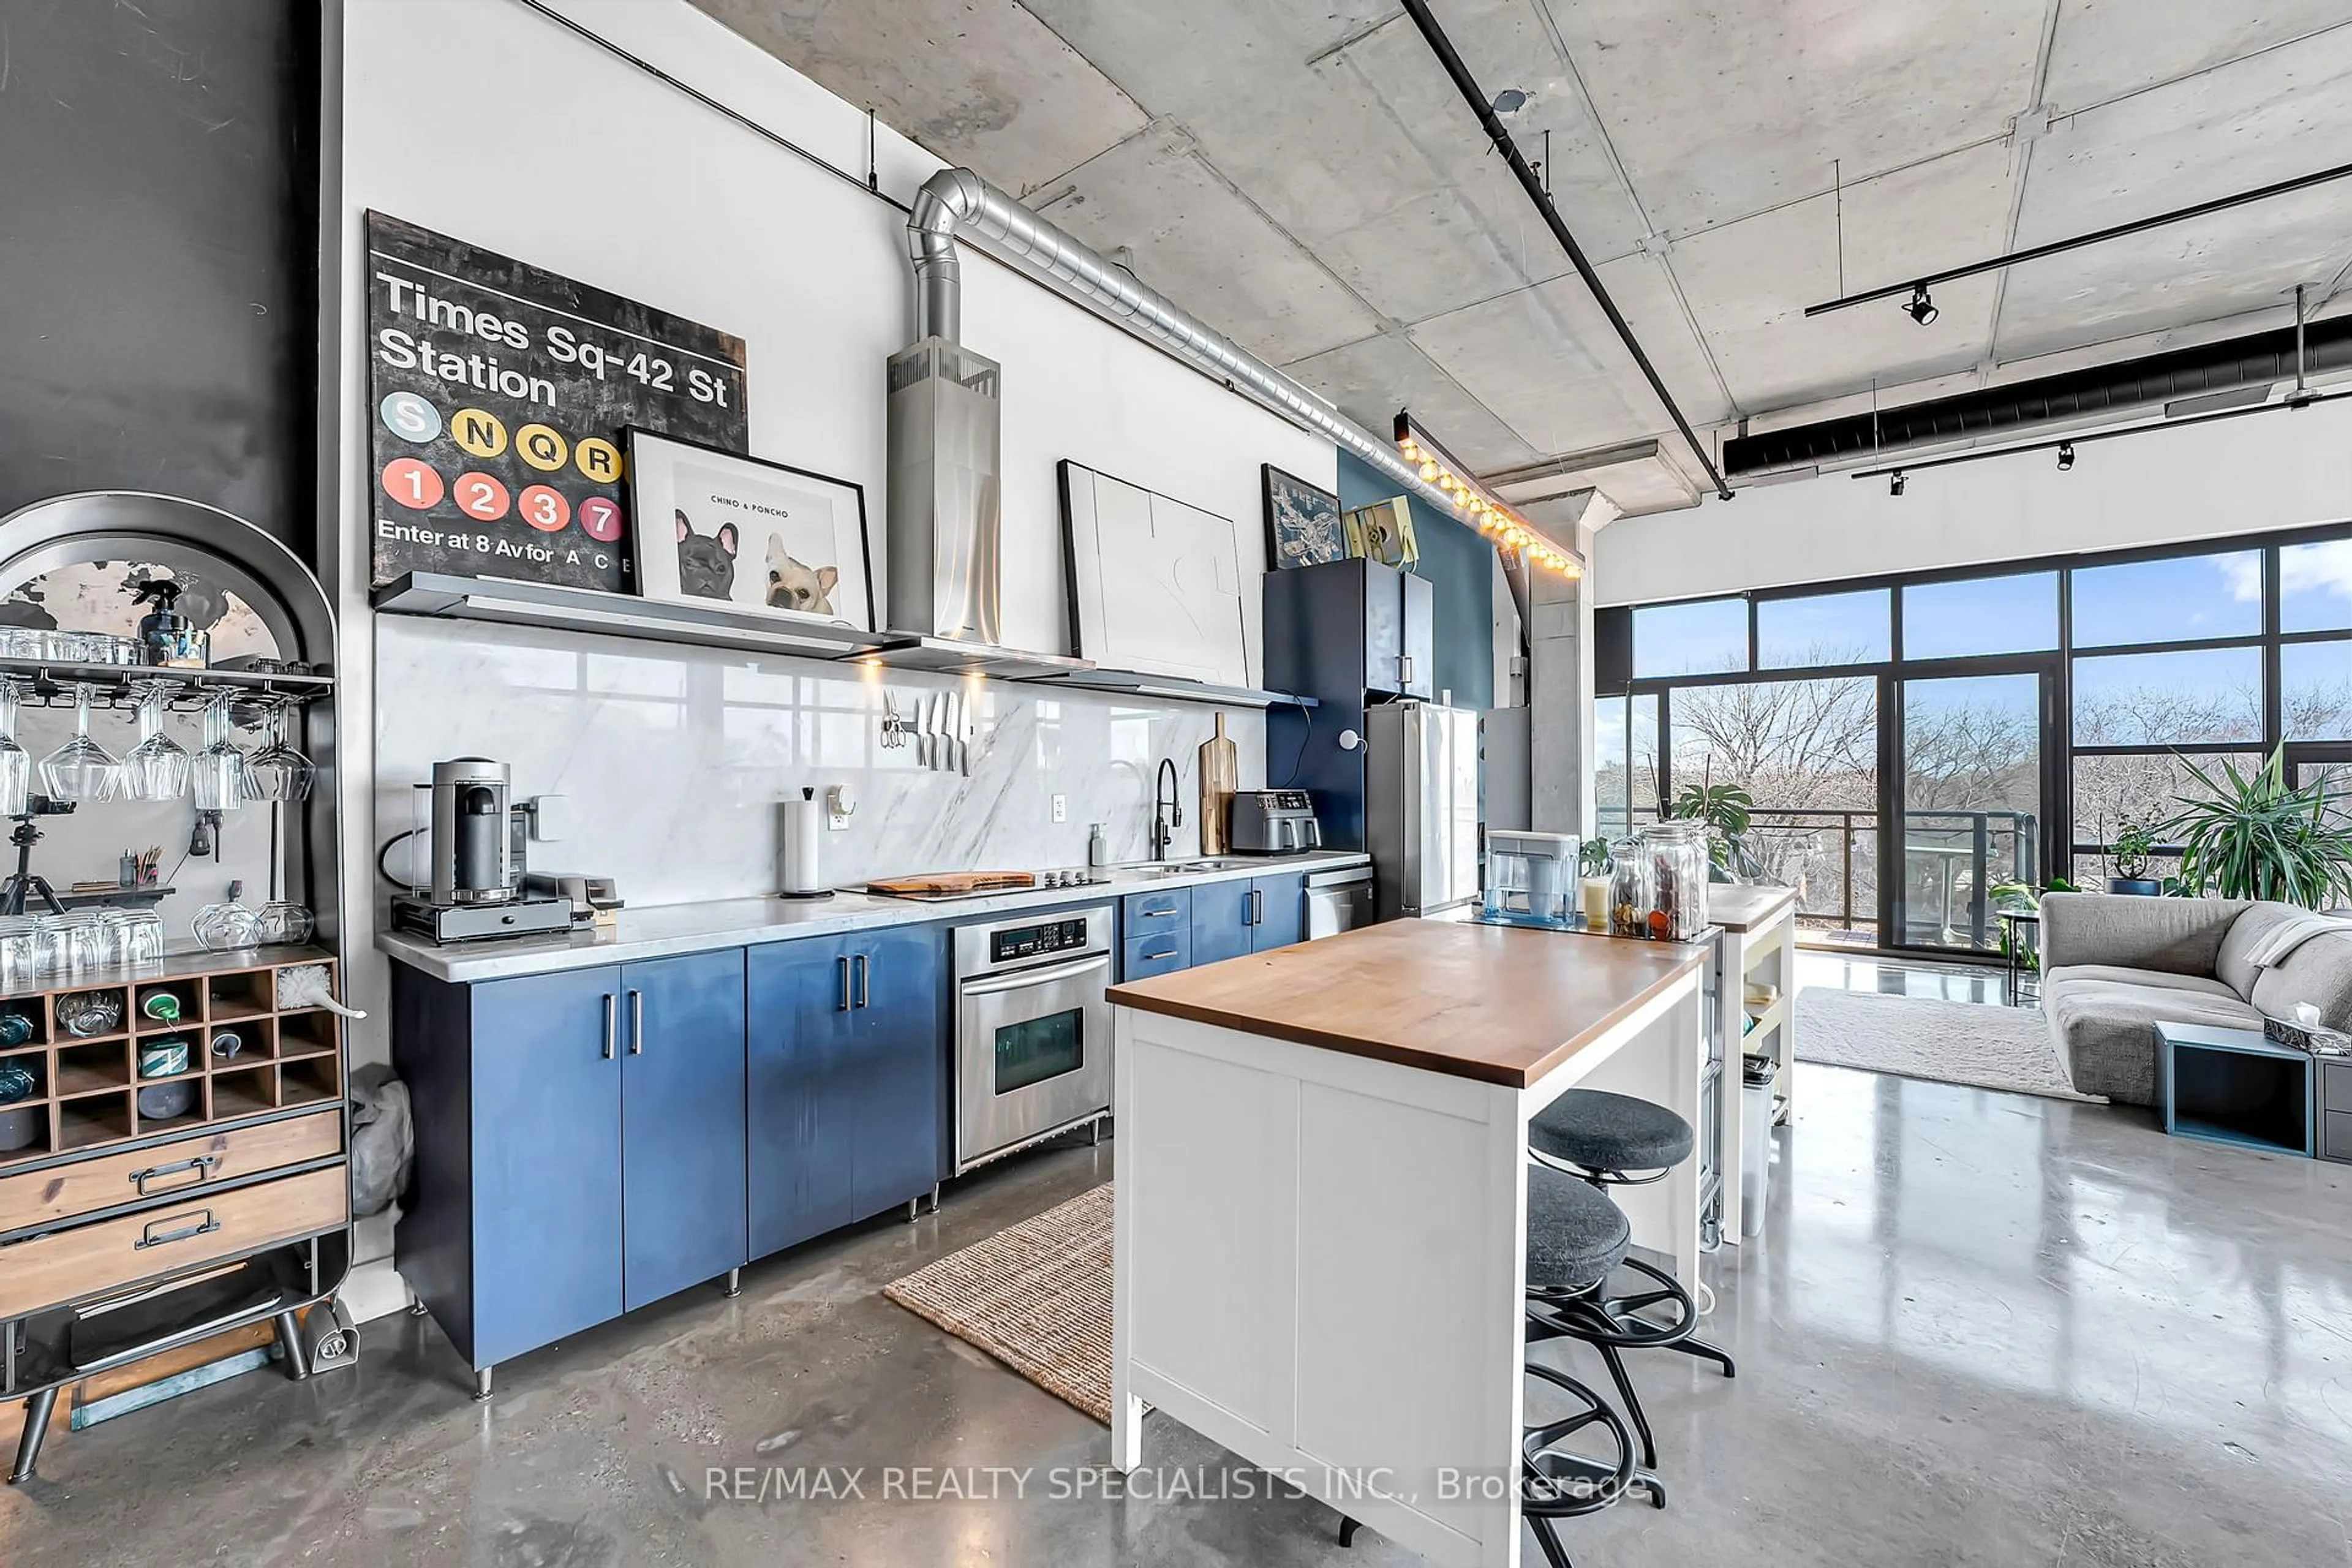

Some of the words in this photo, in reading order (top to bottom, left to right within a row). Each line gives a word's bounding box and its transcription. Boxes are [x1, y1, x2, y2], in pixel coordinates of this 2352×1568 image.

[376, 271, 529, 349] Times
[546, 326, 674, 393] Sq-42
[688, 369, 728, 408] St
[379, 328, 556, 407] Station
[394, 401, 426, 433] S
[466, 417, 494, 448] N
[529, 433, 557, 463] Q
[588, 447, 611, 474] R
[404, 470, 423, 500] 1
[470, 482, 495, 513] 2
[533, 493, 557, 525] 3
[591, 505, 612, 532] 7
[710, 495, 739, 508] CHINO
[752, 504, 788, 518] PONCHO
[377, 519, 444, 546] Enter
[448, 530, 470, 550] at
[476, 535, 490, 552] 8
[495, 539, 523, 559] Av
[525, 544, 554, 562] for
[565, 550, 581, 565] A
[594, 554, 610, 570] C
